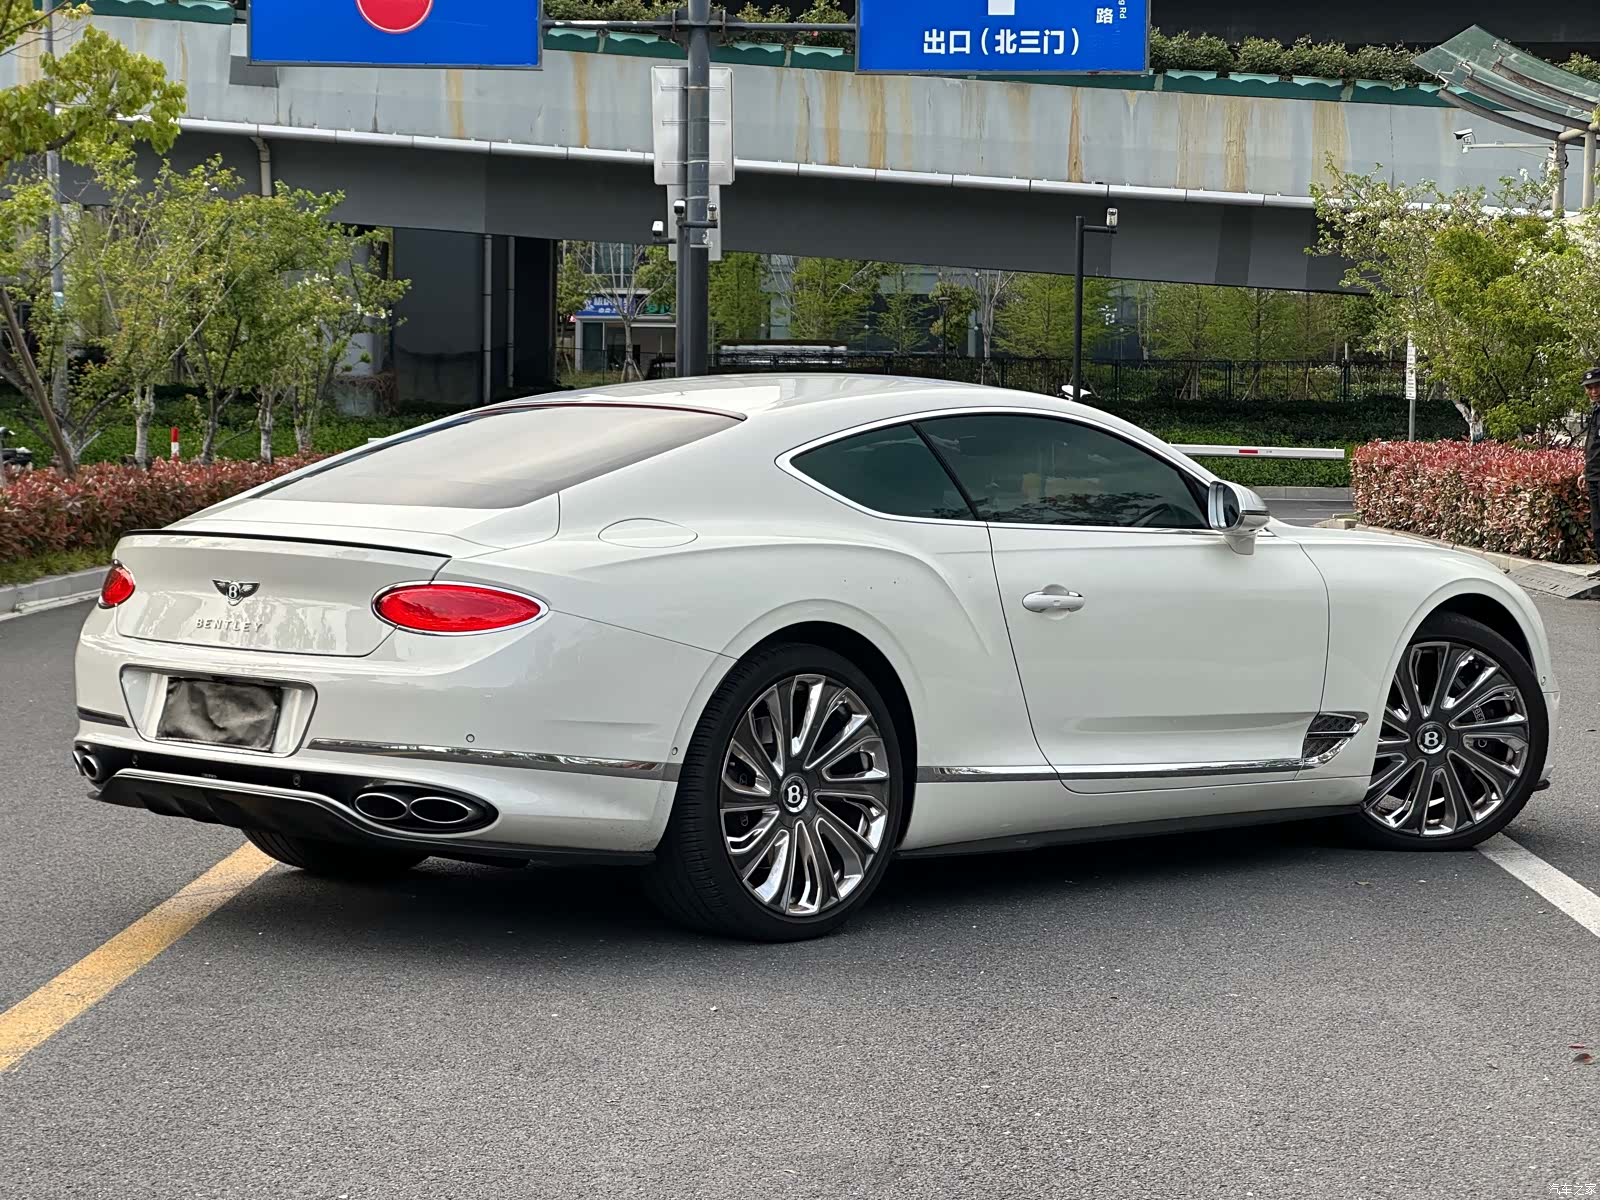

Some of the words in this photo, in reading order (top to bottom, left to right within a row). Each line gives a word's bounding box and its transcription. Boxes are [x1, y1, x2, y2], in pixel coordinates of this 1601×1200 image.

[1096, 7, 1113, 24] 路
[1119, 7, 1127, 19] Rd
[923, 27, 1079, 55] 出口（北三门）
[196, 618, 263, 633] BENTLEY
[1424, 731, 1439, 747] B
[787, 785, 801, 804] B
